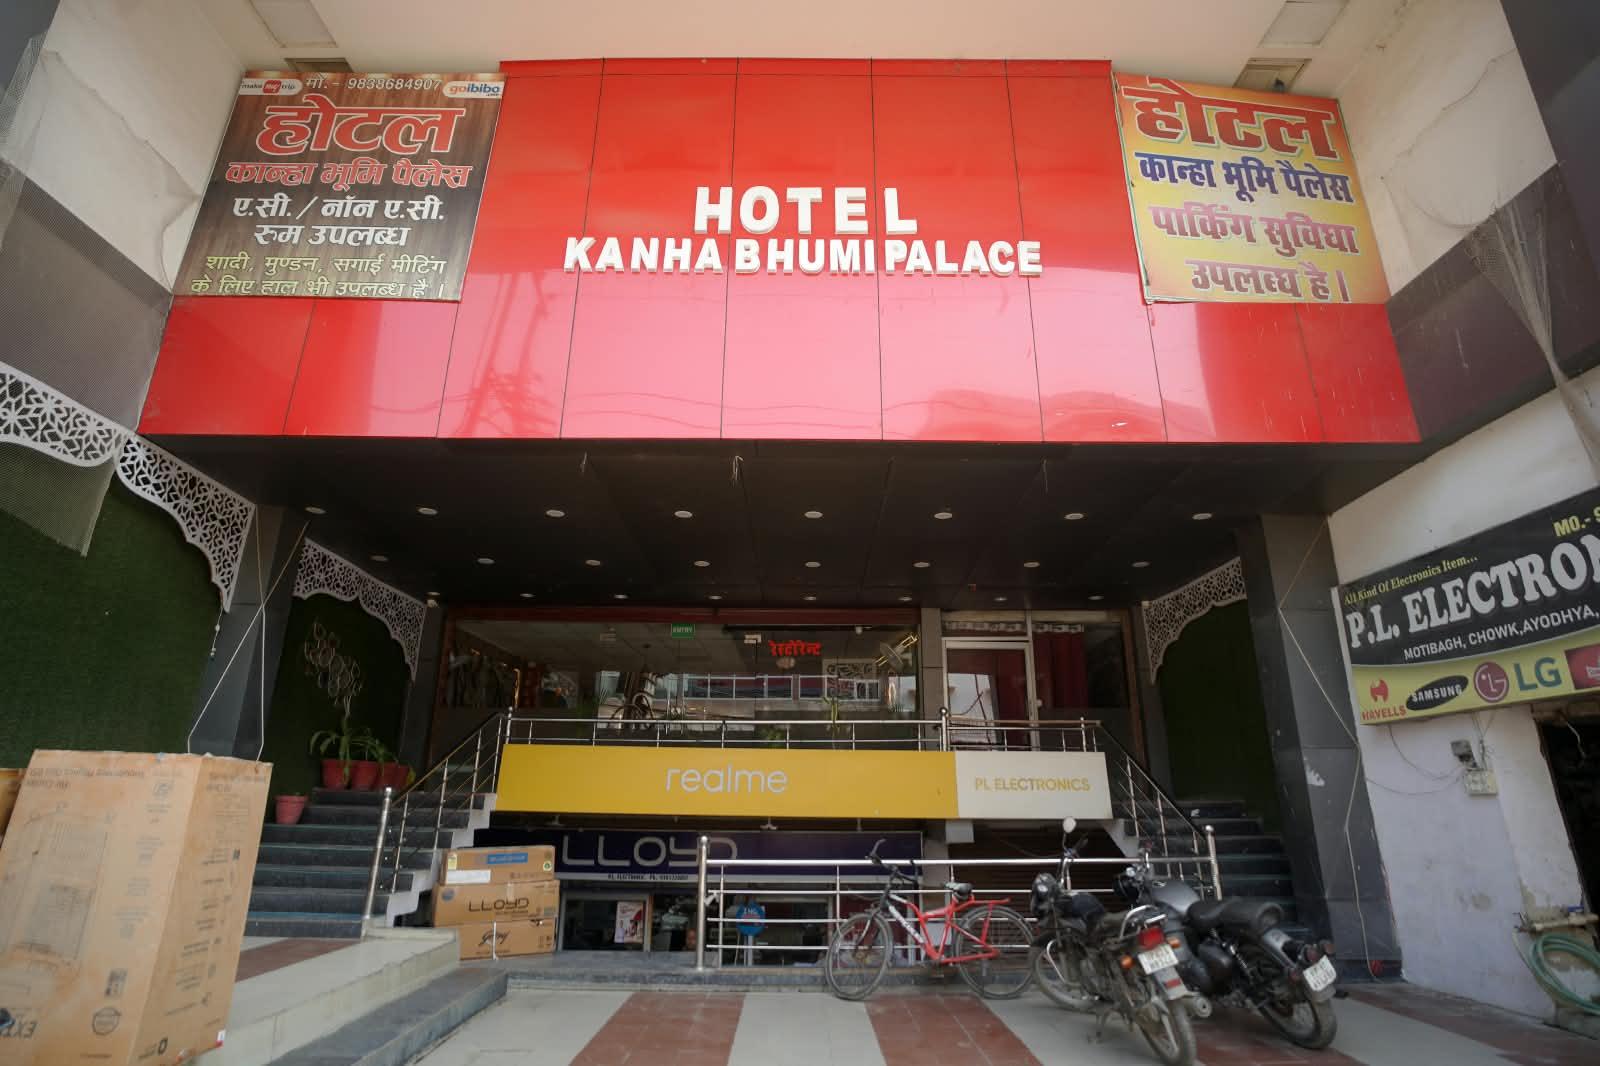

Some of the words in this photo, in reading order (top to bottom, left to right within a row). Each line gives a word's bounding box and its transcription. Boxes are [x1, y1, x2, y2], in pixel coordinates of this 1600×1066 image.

[347, 78, 442, 91] 9838684907
[448, 83, 500, 94] goibibo
[255, 93, 466, 156] होटल
[1121, 76, 1339, 161] होटल
[225, 162, 318, 187] कान्हा
[320, 157, 388, 192] भूमि
[391, 158, 473, 189] पैलेस
[1134, 152, 1217, 188] कान्हा
[1222, 156, 1279, 203] भूमि
[1276, 159, 1354, 203] पैलेस
[232, 192, 292, 218] ए.सी.
[383, 194, 445, 221] ए.सी.
[694, 186, 918, 235] HOTEL
[308, 225, 412, 247] उपलब्ध
[333, 253, 386, 276] सगाई
[391, 254, 447, 274] मीटिंग
[564, 237, 724, 275] KANHA
[735, 238, 875, 276] BHUMI
[885, 239, 1043, 277] PALACE
[191, 276, 213, 293] के
[219, 275, 255, 294] लिए
[261, 280, 297, 295] हाल
[306, 275, 330, 296] भी
[335, 281, 406, 297] उपलब्ध
[1299, 261, 1330, 300] है
[1344, 591, 1357, 605] All
[1357, 585, 1377, 601] Kind
[1378, 580, 1389, 594] Of
[1391, 564, 1441, 589] Electronics
[1346, 604, 1400, 648] P.L.
[1404, 636, 1467, 660] MOTIBAGH,
[1513, 656, 1563, 692] LG
[1412, 684, 1463, 703] SAMSUNG
[1362, 705, 1407, 721] HAVELLS
[665, 764, 788, 793] realme
[975, 777, 991, 791] PL
[995, 777, 1091, 791] ELECTRONICS
[562, 834, 738, 867] LLOYD
[468, 898, 530, 912] LLOYD
